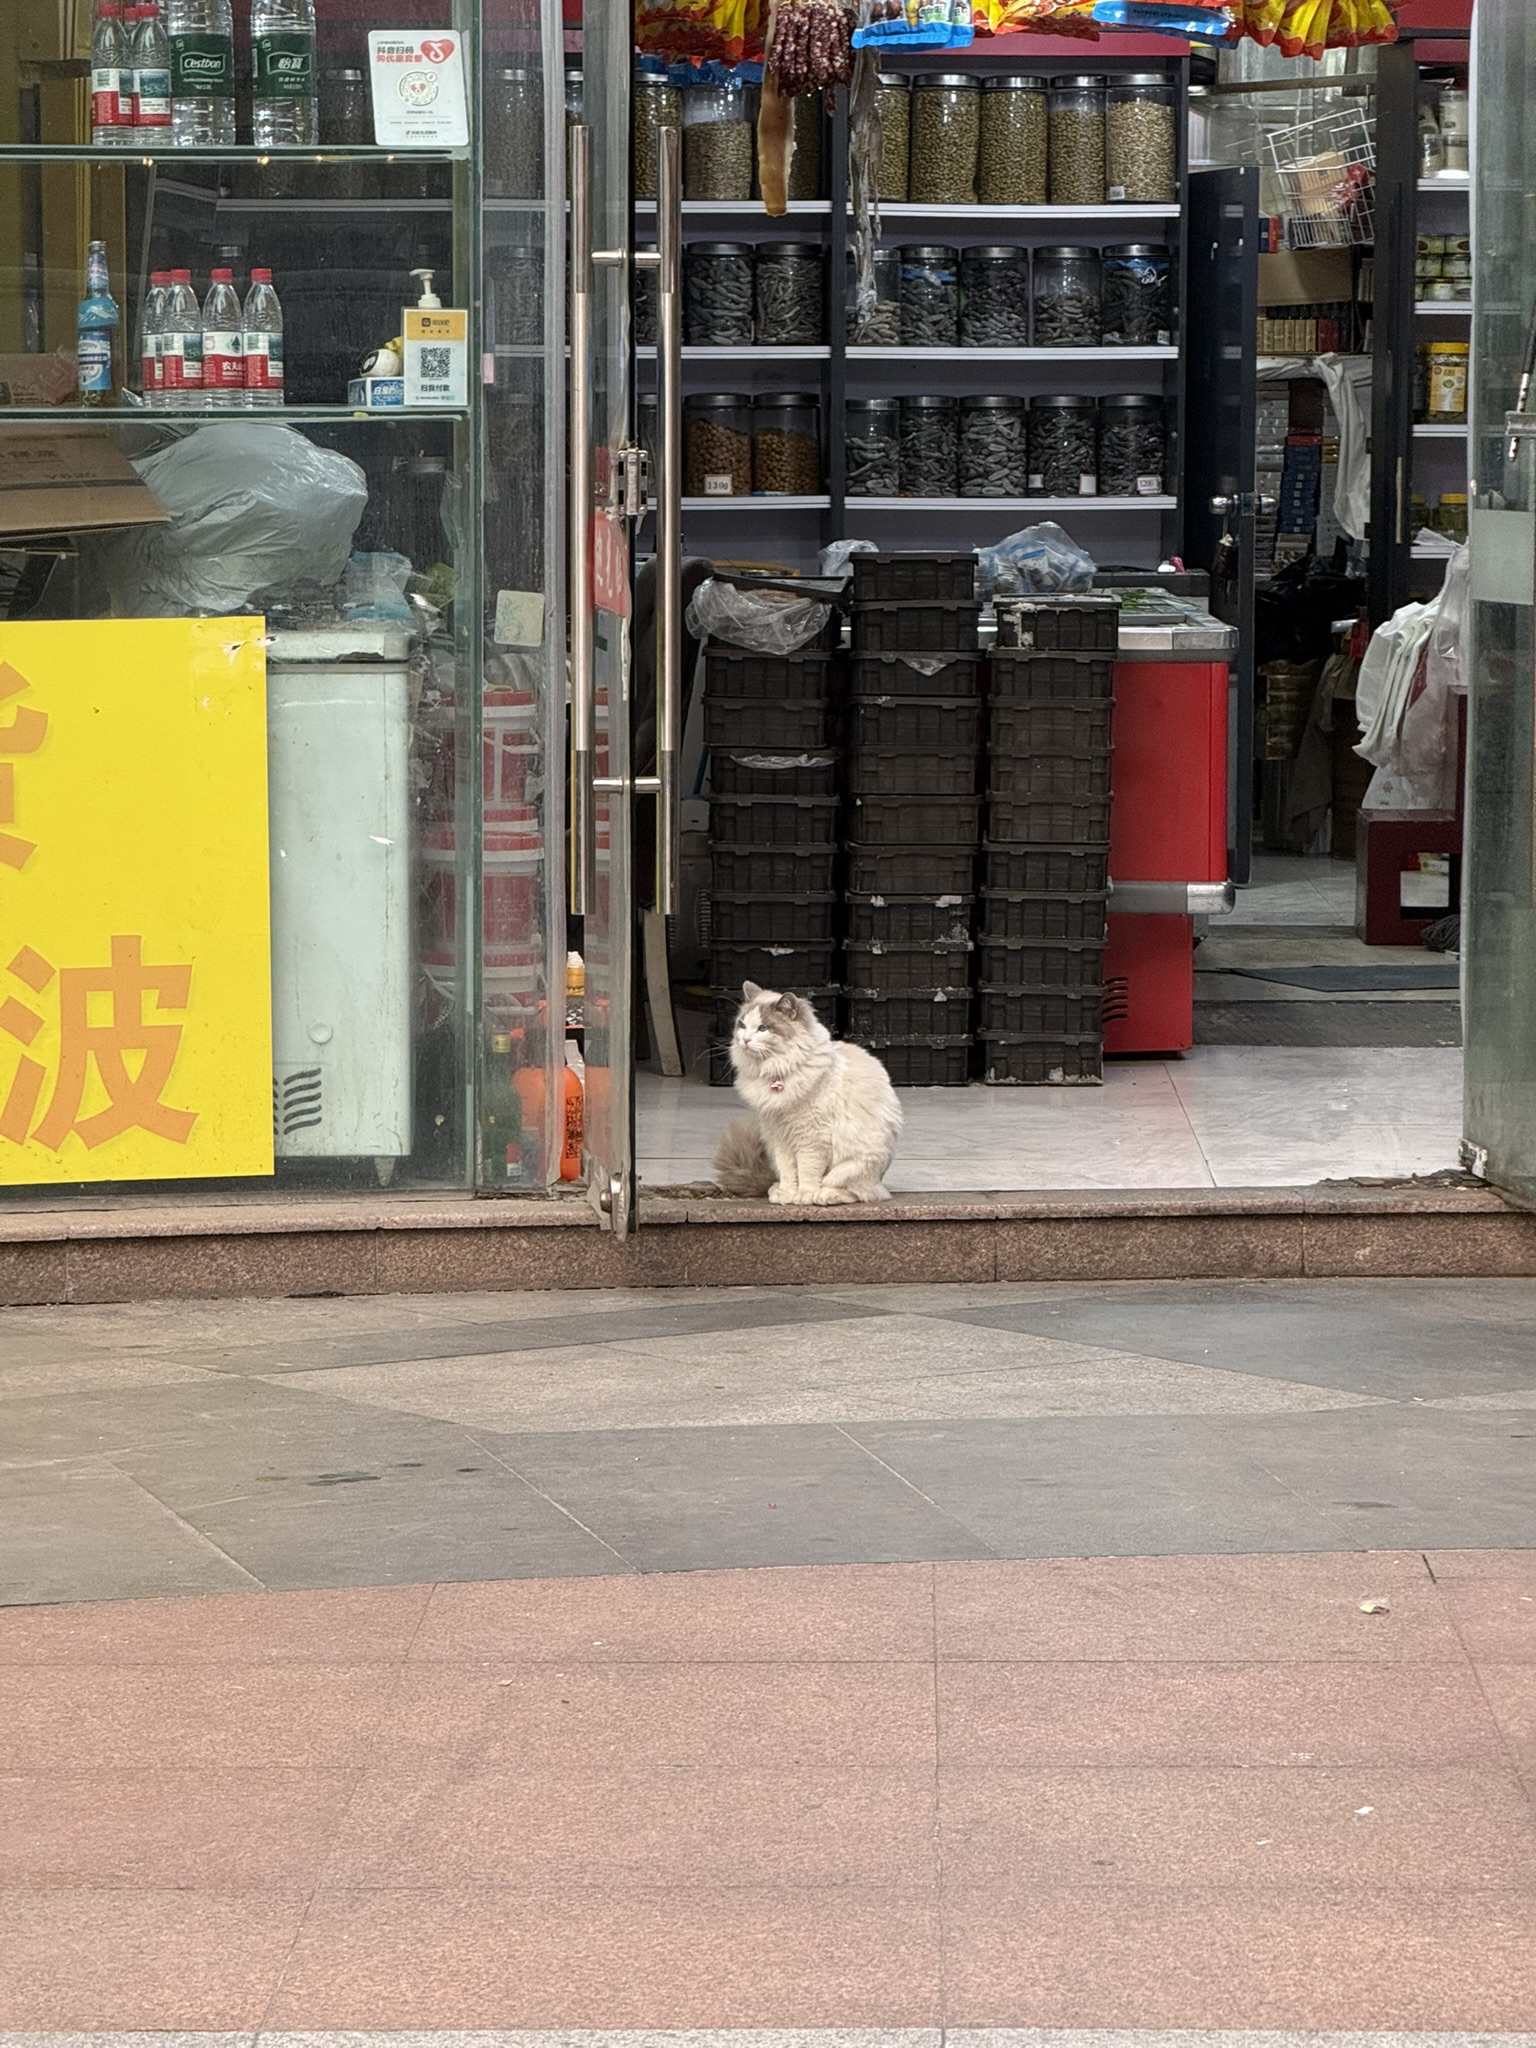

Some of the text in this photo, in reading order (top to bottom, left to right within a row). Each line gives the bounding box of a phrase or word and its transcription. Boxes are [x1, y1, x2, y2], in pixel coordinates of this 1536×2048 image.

[184, 59, 222, 69] Cestbon
[420, 384, 450, 392] 扫我付款
[0, 935, 200, 1153] 波
